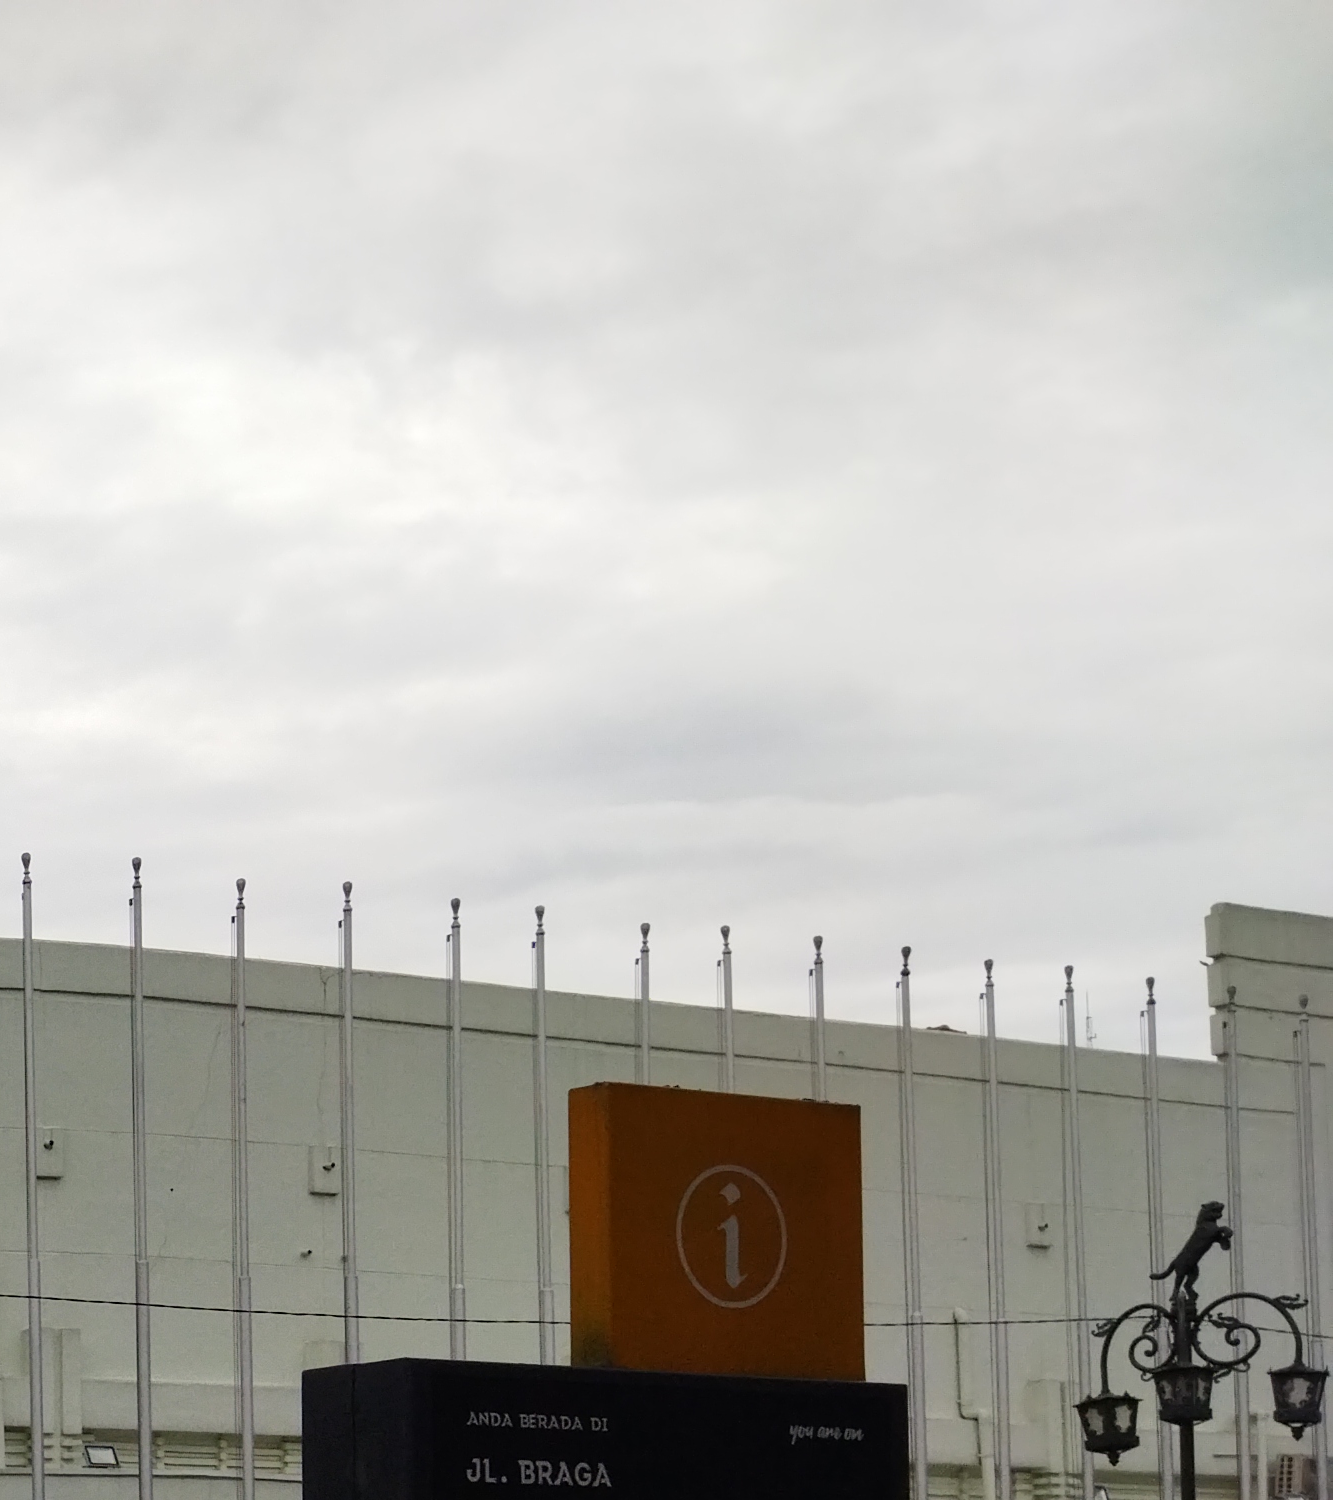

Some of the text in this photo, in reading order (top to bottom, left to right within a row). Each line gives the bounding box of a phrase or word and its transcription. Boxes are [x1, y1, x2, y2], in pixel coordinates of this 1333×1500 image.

[466, 1411, 609, 1432] ANDA BERADA DI
[789, 1424, 864, 1445] you are on
[465, 1457, 613, 1488] JL. BRAGA
